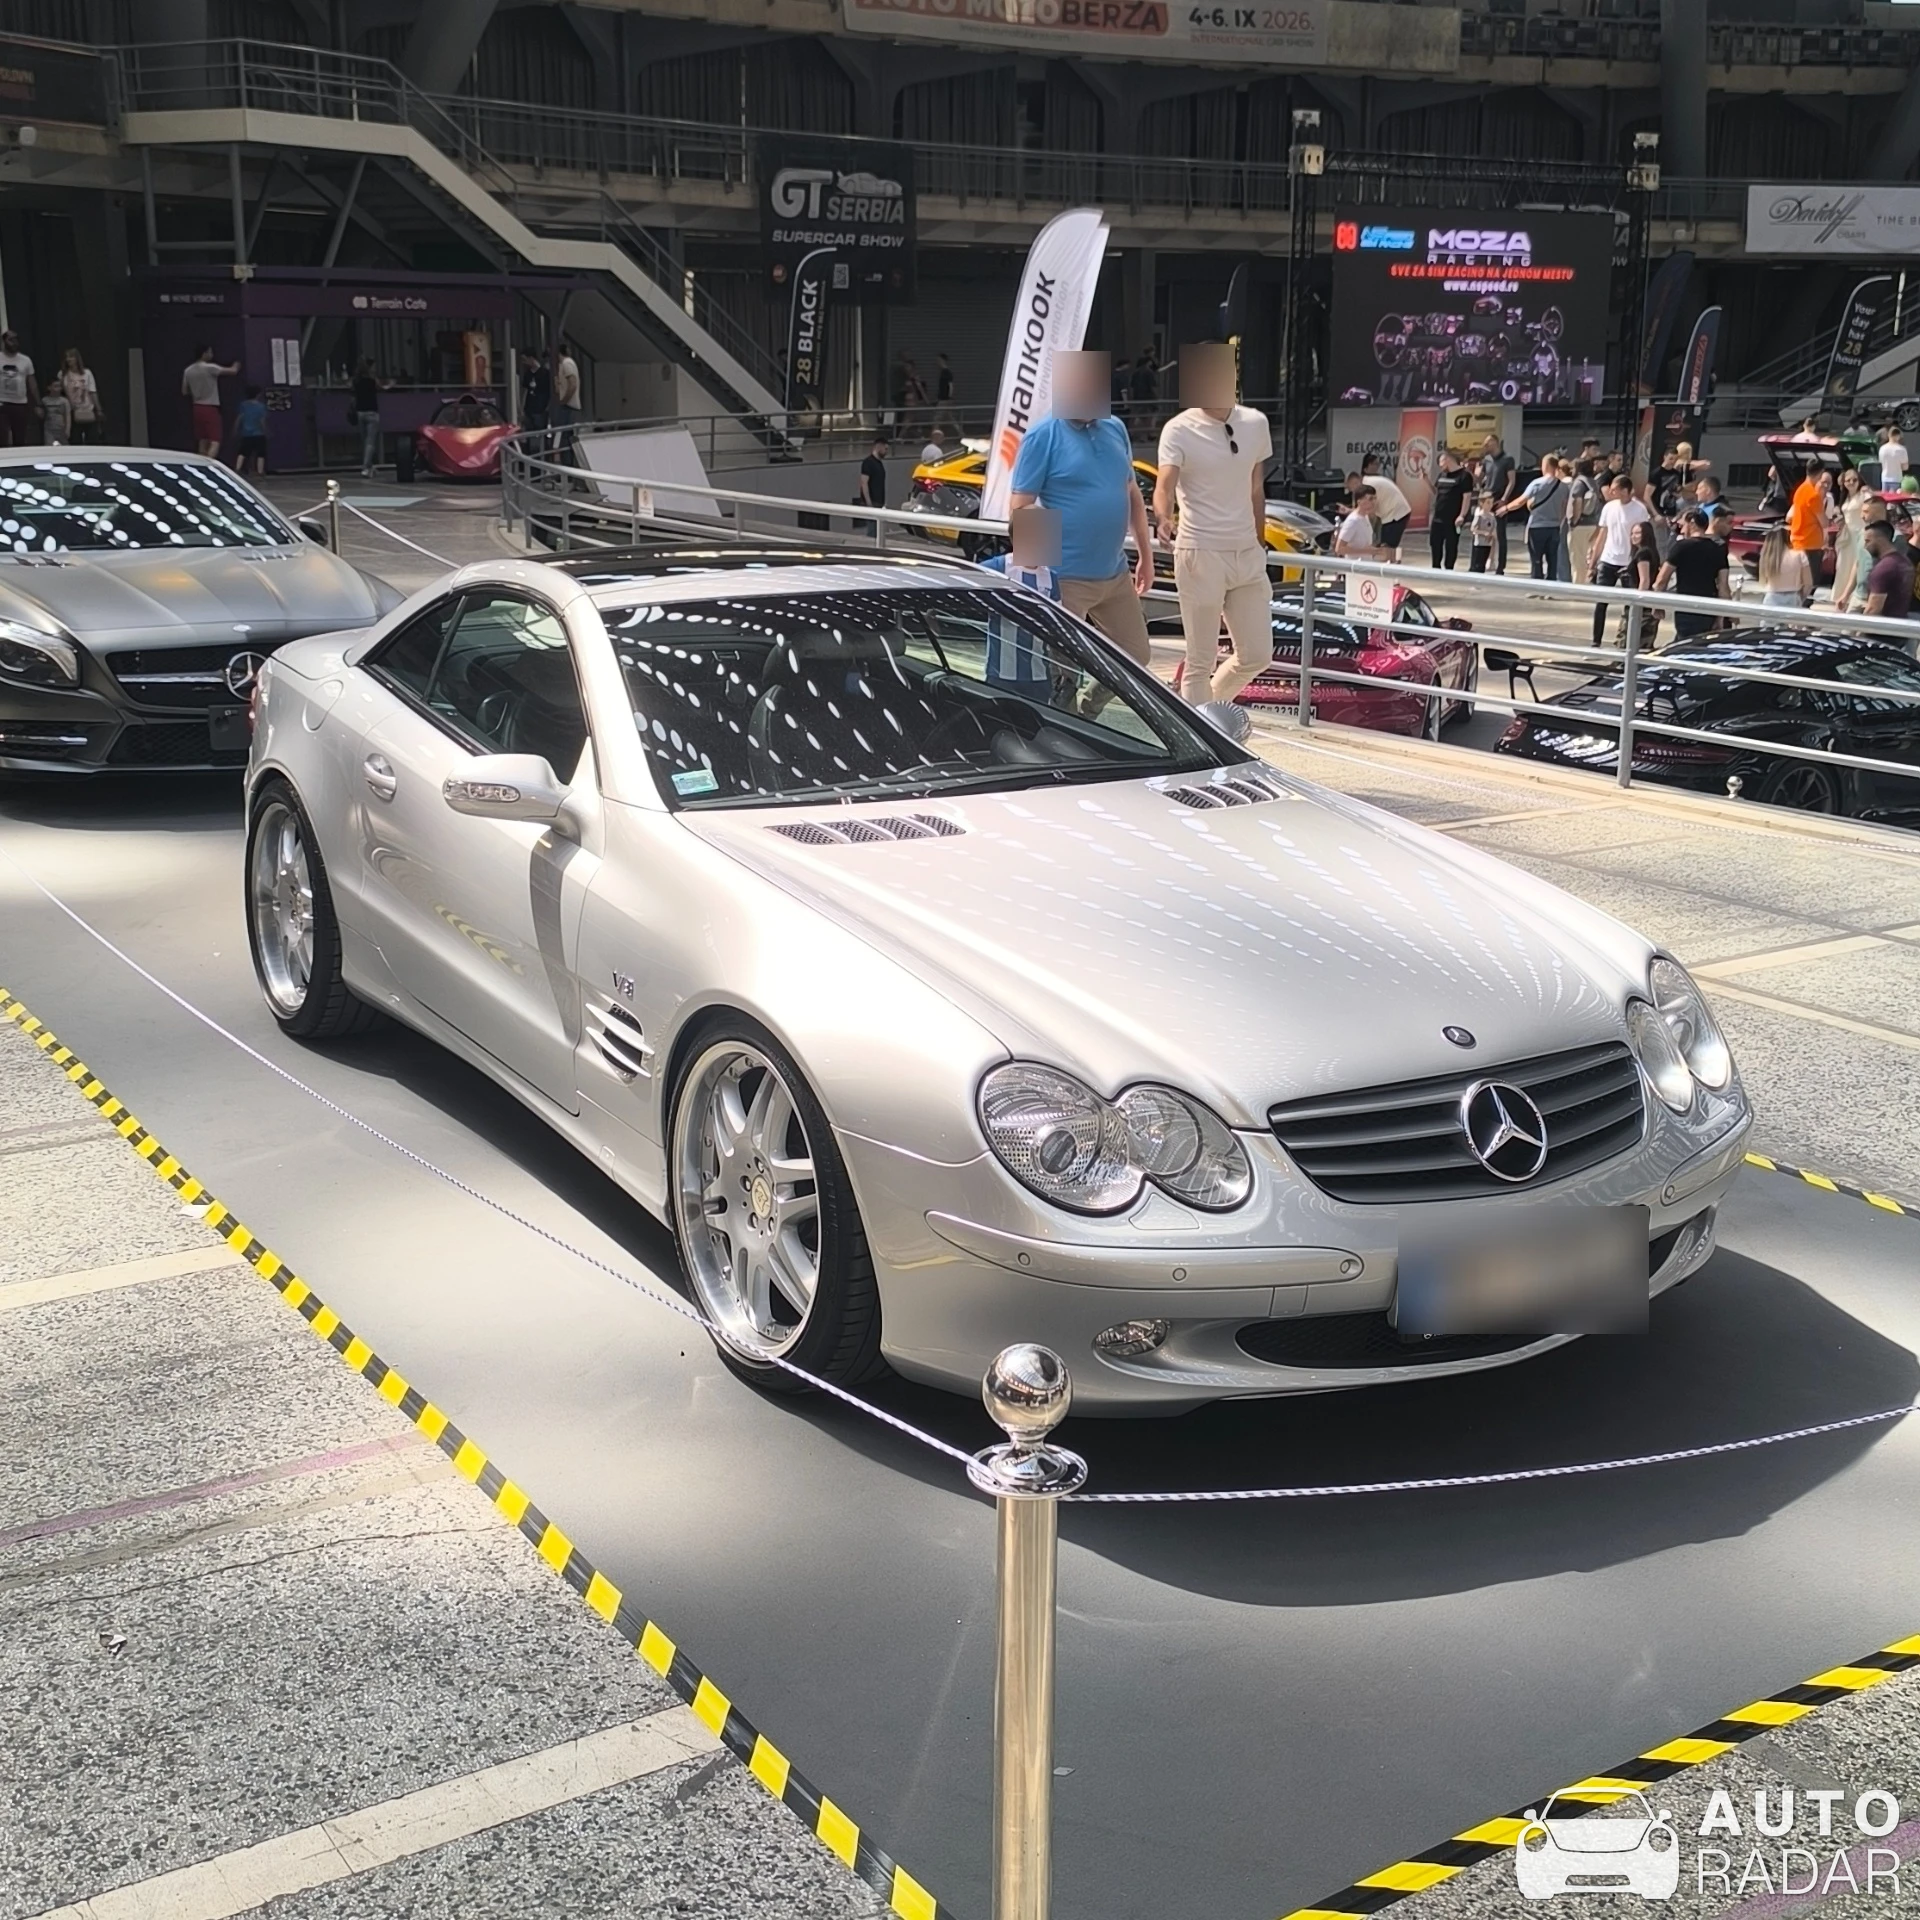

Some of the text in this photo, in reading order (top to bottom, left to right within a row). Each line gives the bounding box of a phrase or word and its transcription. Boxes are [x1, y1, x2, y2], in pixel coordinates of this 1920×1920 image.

[1188, 7, 1316, 30] 4-6. IX 2026.
[771, 168, 833, 219] GT
[826, 196, 904, 225] SERBIA
[1877, 215, 1904, 226] TIME
[772, 229, 905, 248] SUPERCAR SHOW
[1427, 228, 1532, 251] MOZA
[1426, 254, 1532, 266] RACING
[1412, 265, 1425, 277] ZA
[1427, 265, 1447, 277] SIM
[1486, 266, 1500, 278] NA
[1502, 266, 1542, 279] JEDNOM
[1542, 268, 1575, 280] MESTU
[1051, 281, 1070, 344] emotion
[1854, 302, 1876, 316] Your
[1851, 316, 1870, 330] day
[796, 279, 818, 385] 28 BLACK
[1848, 328, 1865, 340] has
[1842, 340, 1862, 355] 28
[1454, 413, 1473, 429] GT
[611, 969, 635, 1001] V8
